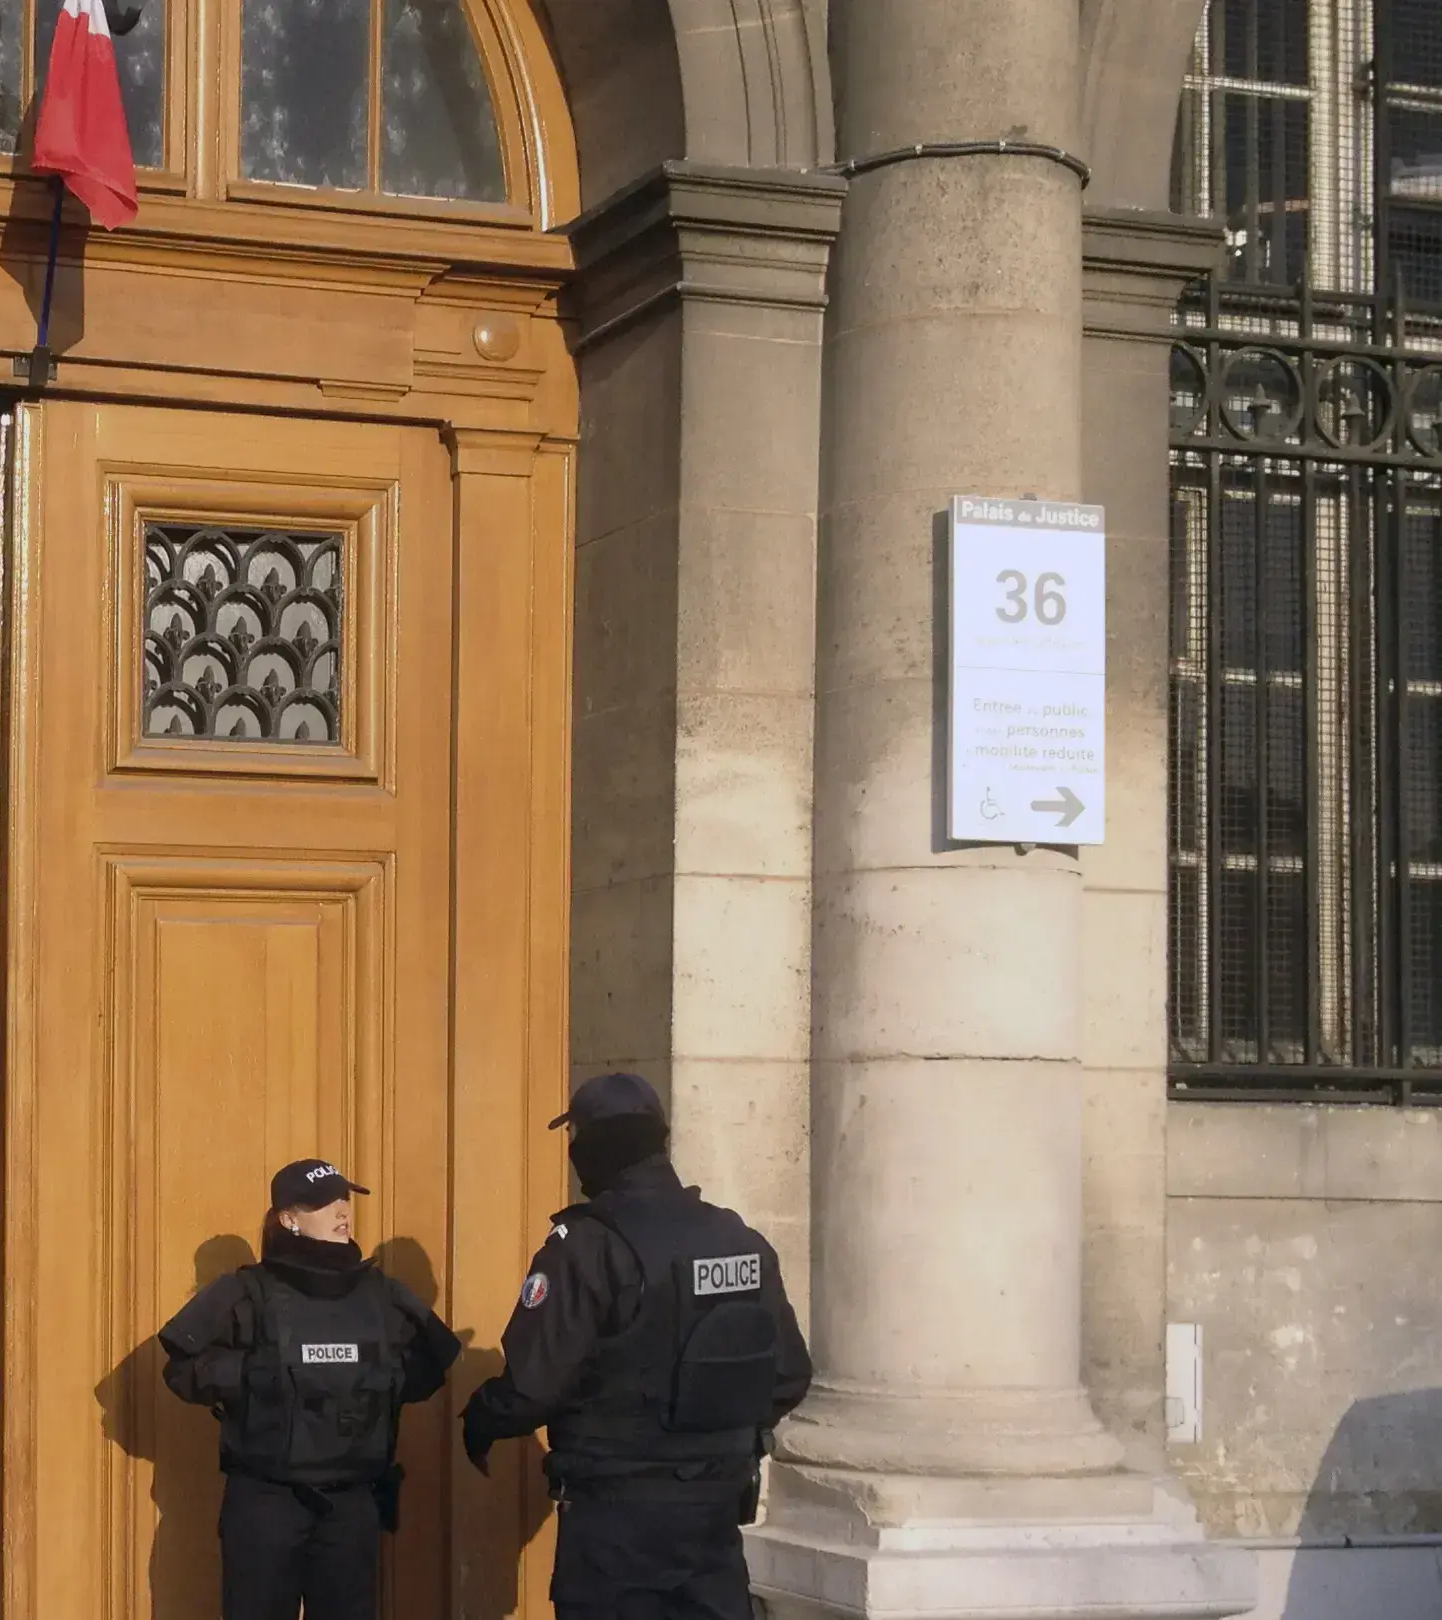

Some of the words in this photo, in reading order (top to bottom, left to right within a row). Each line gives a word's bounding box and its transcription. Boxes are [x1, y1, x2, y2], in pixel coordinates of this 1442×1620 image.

[961, 501, 1014, 521] Palais
[1035, 506, 1100, 527] Justice
[995, 569, 1067, 626] 36
[1043, 702, 1088, 718] public
[1007, 725, 1085, 738] personnes
[698, 1260, 757, 1290] POLICE
[308, 1347, 352, 1360] POLICE
